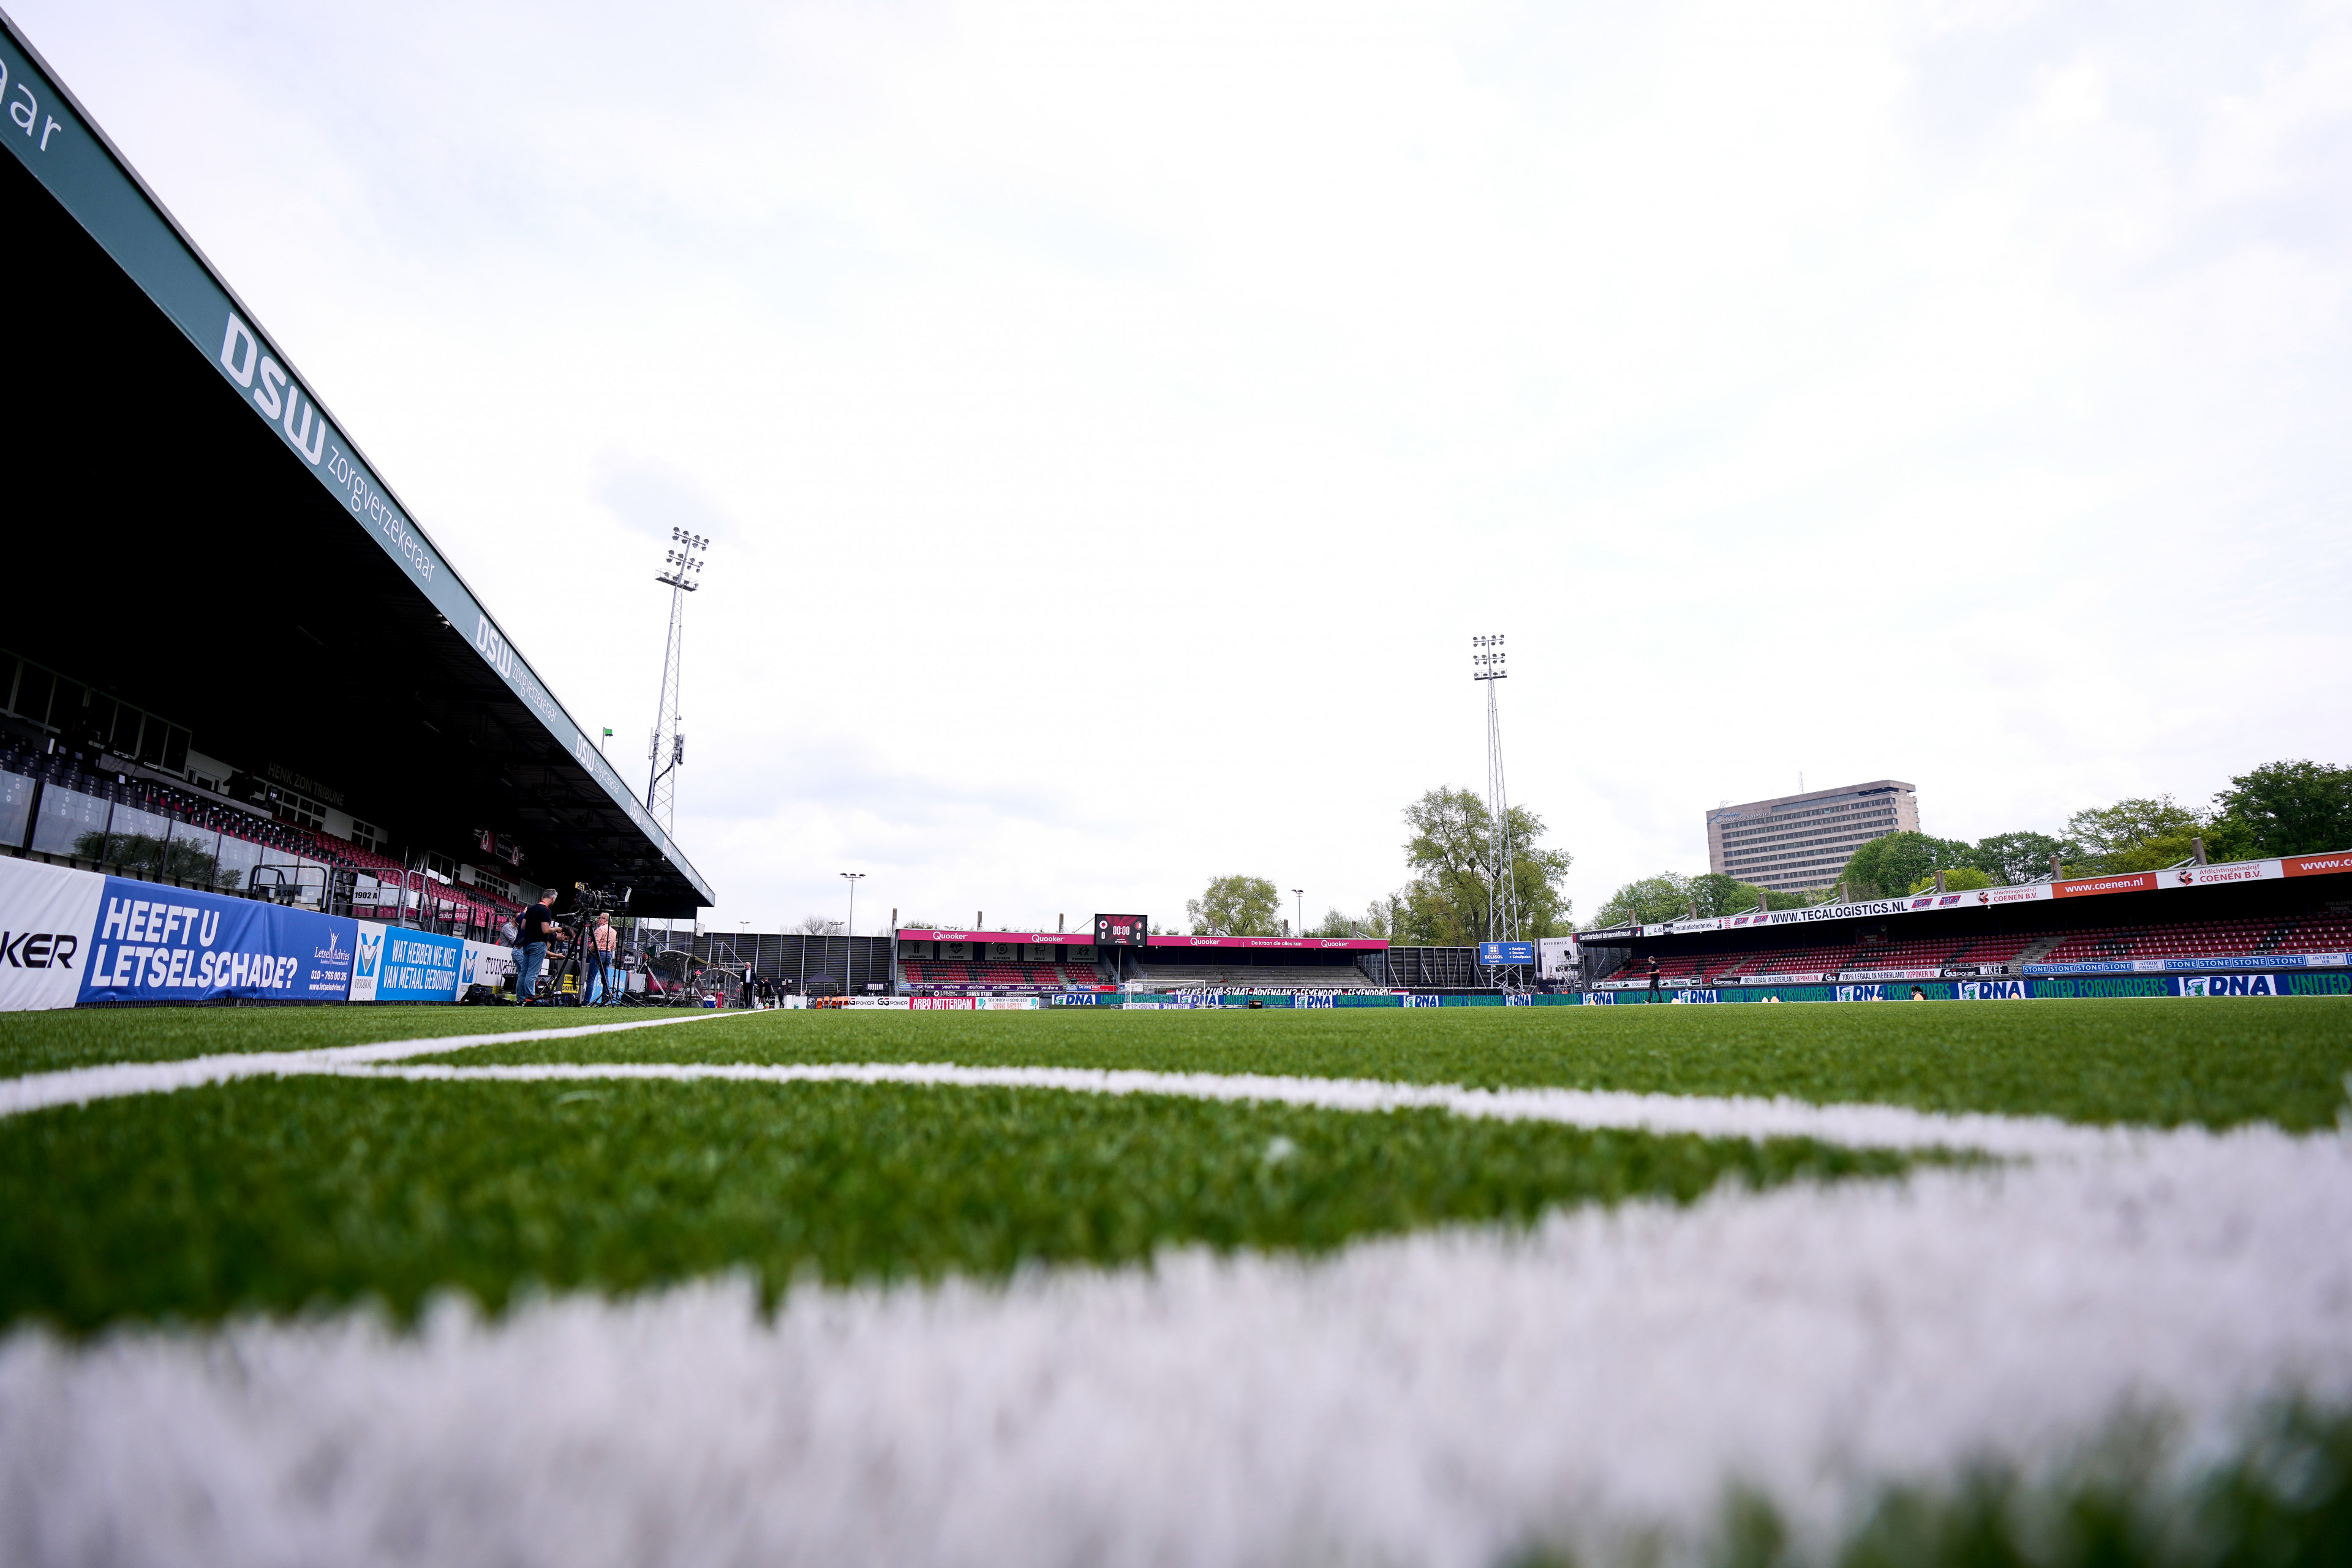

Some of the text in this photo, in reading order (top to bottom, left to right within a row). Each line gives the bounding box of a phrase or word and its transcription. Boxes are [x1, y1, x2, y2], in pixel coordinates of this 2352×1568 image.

[220, 312, 435, 582] DSW zorgverzekeraar
[476, 614, 557, 724] DSW zorgverzekeraar
[576, 734, 619, 796] DSW zorgverzekeraar
[268, 761, 344, 807] HENK ZON TRIBUNE
[629, 797, 642, 824] DSW
[663, 837, 672, 858] DSW
[2199, 864, 2260, 875] Afdichtingsbedrijf
[2301, 859, 2352, 870] www.c
[2200, 872, 2242, 883] COENEN
[1993, 887, 2037, 895] Afdichtingsbedrijf
[2065, 877, 2144, 893] www.coenen.nl
[1942, 896, 1958, 905] TECA
[1994, 894, 2024, 902] COENEN
[1771, 901, 1909, 924] WWW.TECALOGISTICS.NL
[102, 897, 220, 947] HEEFT U
[933, 931, 966, 940] Quooker
[1113, 926, 1130, 935] 00:00
[1603, 930, 1631, 938] binnenklimaat
[1031, 933, 1063, 943] Quooker
[1190, 937, 1219, 946] Quooker
[314, 946, 350, 960] Letsel Advies
[392, 940, 456, 968] WAT HEBBEN WE NIET
[91, 944, 298, 989] LETSELSCHADE?
[311, 970, 347, 981] 010 766 00 35
[383, 965, 456, 990] VAN METAAL GEBOUWD?
[1877, 970, 1905, 979] NEDERLAND
[1905, 970, 1936, 978] GGPOKER.NL
[1205, 987, 1223, 995] CLUB
[1226, 986, 1250, 995] STAAT
[1980, 978, 2169, 999] DNA UNITED FORWARDERS
[2209, 974, 2351, 997] DNA UNITED
[1066, 995, 1093, 1005] DNA
[1101, 995, 1125, 1004] UNITED
[1191, 995, 1216, 1005] DNA
[1223, 995, 1246, 1005] UNITED
[1415, 995, 1504, 1007] DNA UNITED FORWARDERS
[1513, 993, 1580, 1006] DNA UNITED FORWARDERS
[1594, 993, 1635, 1005] DNA UNITED
[1691, 987, 1831, 1003] DNA UNITED FORWARDERS
[913, 998, 972, 1009] ARBO ROTTERDAM
[1307, 995, 1400, 1008] DNA UNITED FORWARDERS
